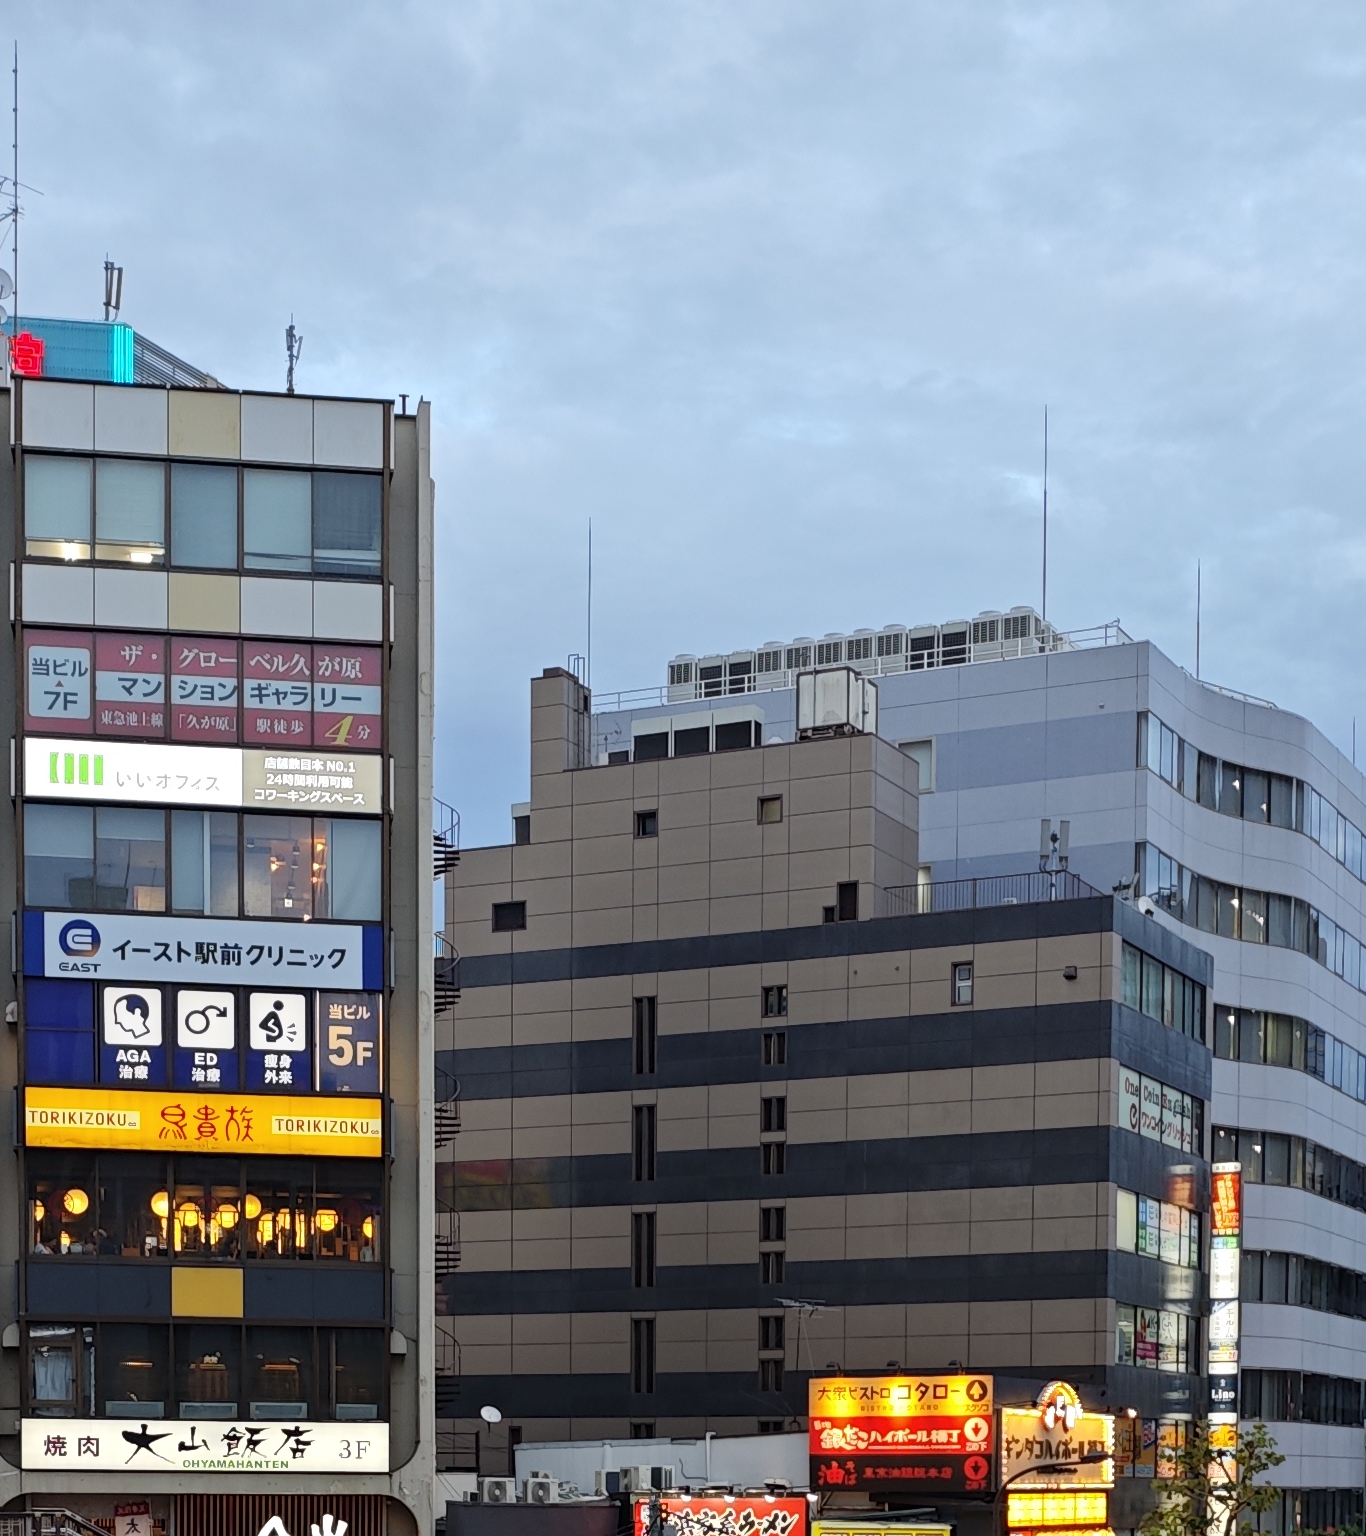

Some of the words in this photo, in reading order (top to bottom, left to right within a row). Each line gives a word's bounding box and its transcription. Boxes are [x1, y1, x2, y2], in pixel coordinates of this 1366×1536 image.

[31, 658, 88, 677] 当ビル
[43, 690, 79, 711] 7F
[254, 788, 366, 806] コワーキングスペース
[111, 940, 348, 970] イースト駅前クリニック
[58, 962, 102, 973] EAST
[328, 1004, 371, 1020] 当ビル
[328, 1026, 375, 1067] 5F
[115, 1049, 152, 1064] AGA
[194, 1052, 219, 1066] ED
[264, 1070, 293, 1085] 外来
[1124, 1076, 1139, 1098] One
[1143, 1084, 1160, 1107] Coin
[29, 1110, 127, 1127] TORIKIZOKU
[274, 1117, 370, 1136] TORIKIZOKU
[897, 1382, 961, 1402] コタロー
[43, 1434, 101, 1458] 焼肉
[121, 1423, 316, 1465] 大山飯店
[338, 1438, 372, 1460] 3F
[182, 1459, 290, 1470] OHYAMAHANTEN
